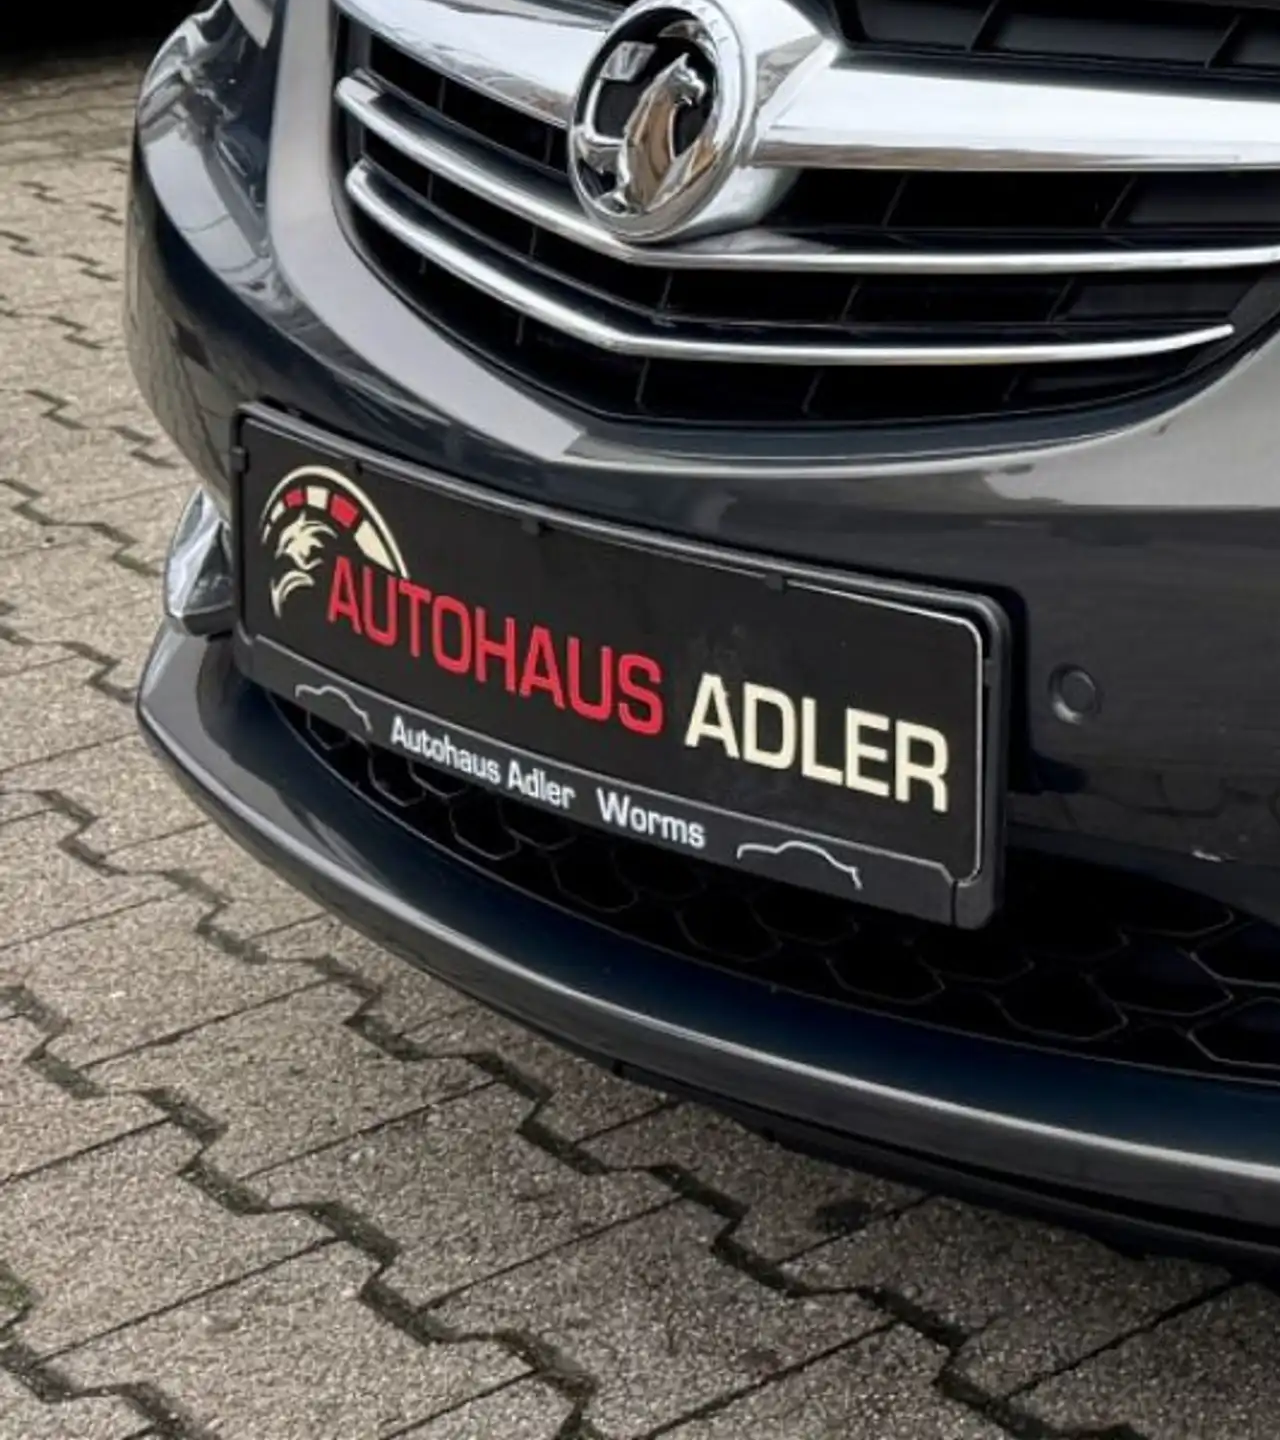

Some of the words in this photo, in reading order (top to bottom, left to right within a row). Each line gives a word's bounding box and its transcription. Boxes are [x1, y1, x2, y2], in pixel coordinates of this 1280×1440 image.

[328, 556, 664, 736] AUTOHAUS
[684, 672, 949, 813] ADLER
[391, 715, 501, 785] Autohaus
[507, 760, 577, 809] Adler
[598, 787, 706, 849] Worms
